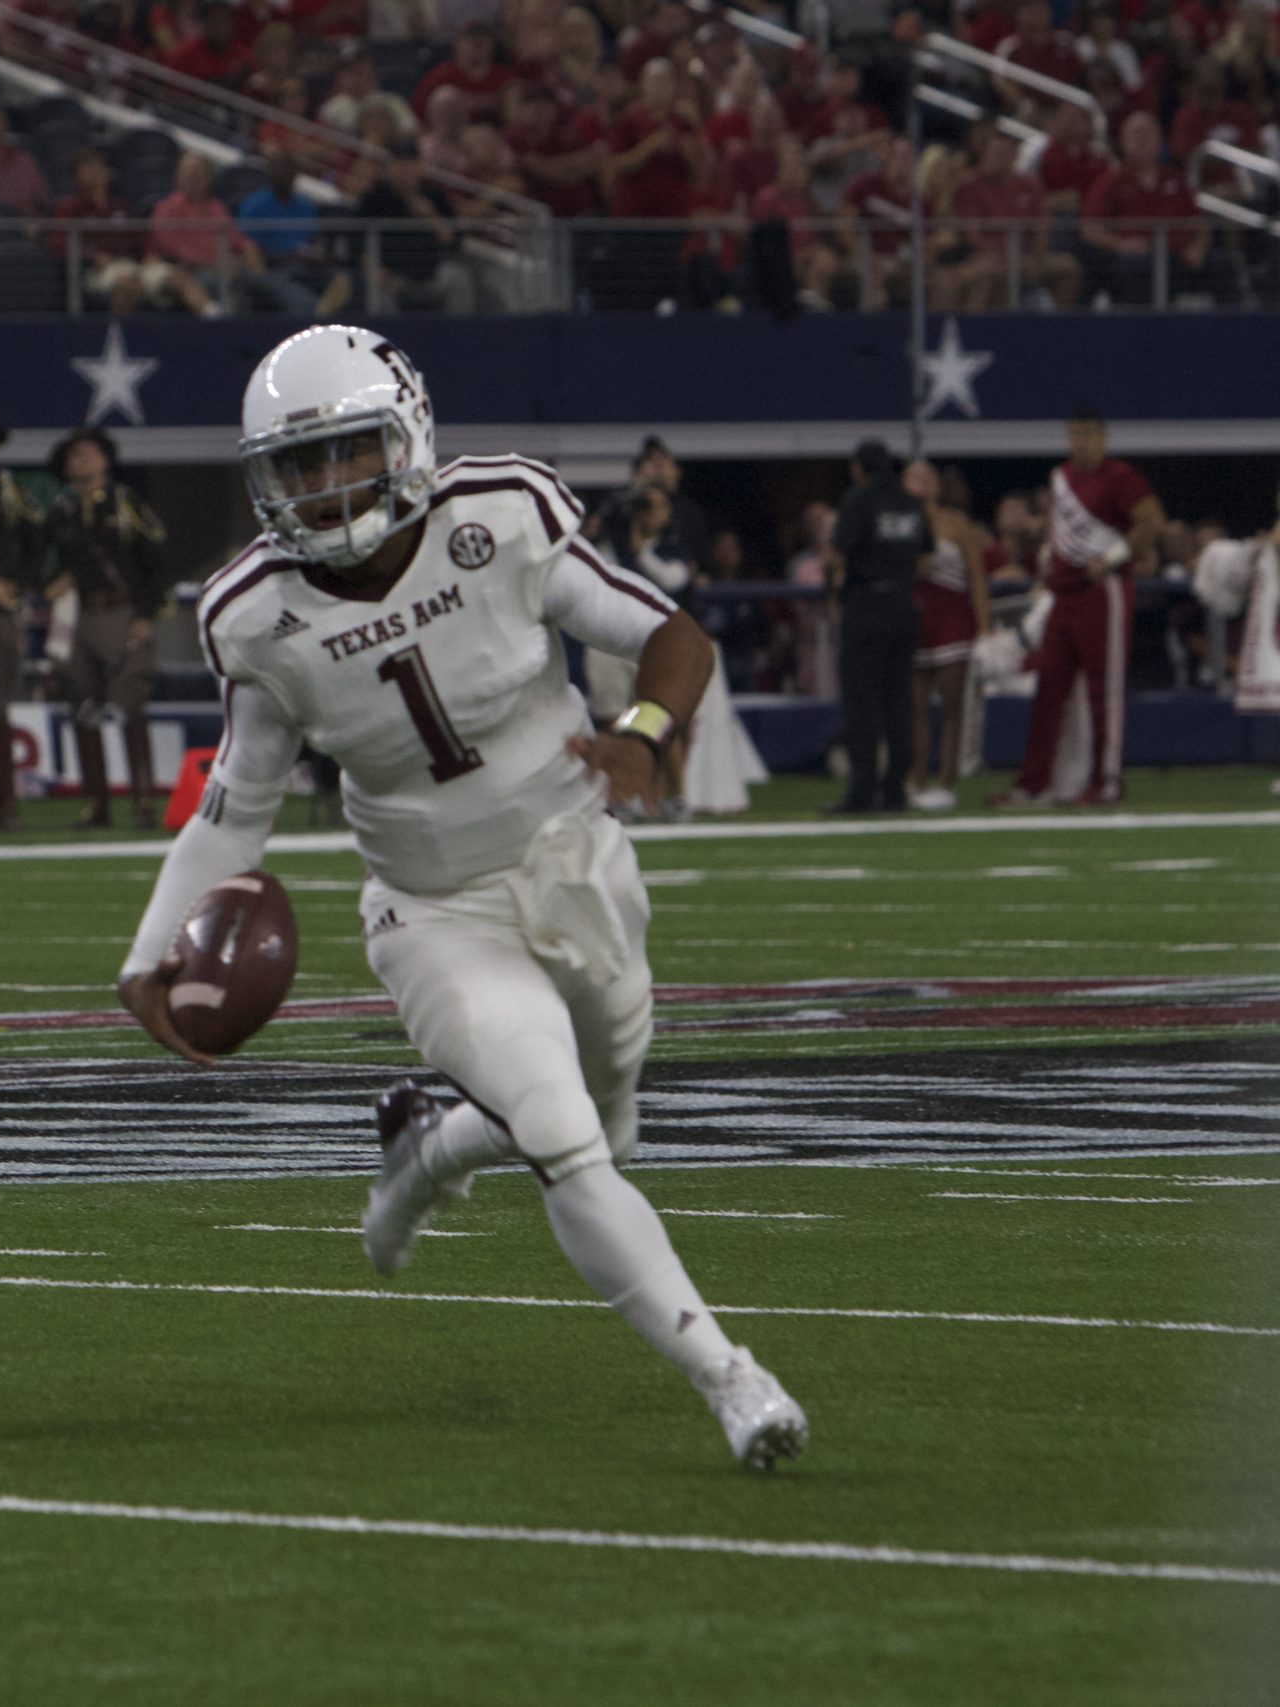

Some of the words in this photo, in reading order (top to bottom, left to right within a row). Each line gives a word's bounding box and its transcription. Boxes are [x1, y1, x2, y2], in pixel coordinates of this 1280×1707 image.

[452, 528, 493, 566] SEC
[322, 612, 407, 661] TEXAS
[412, 584, 464, 627] A&M
[377, 644, 484, 784] 1
